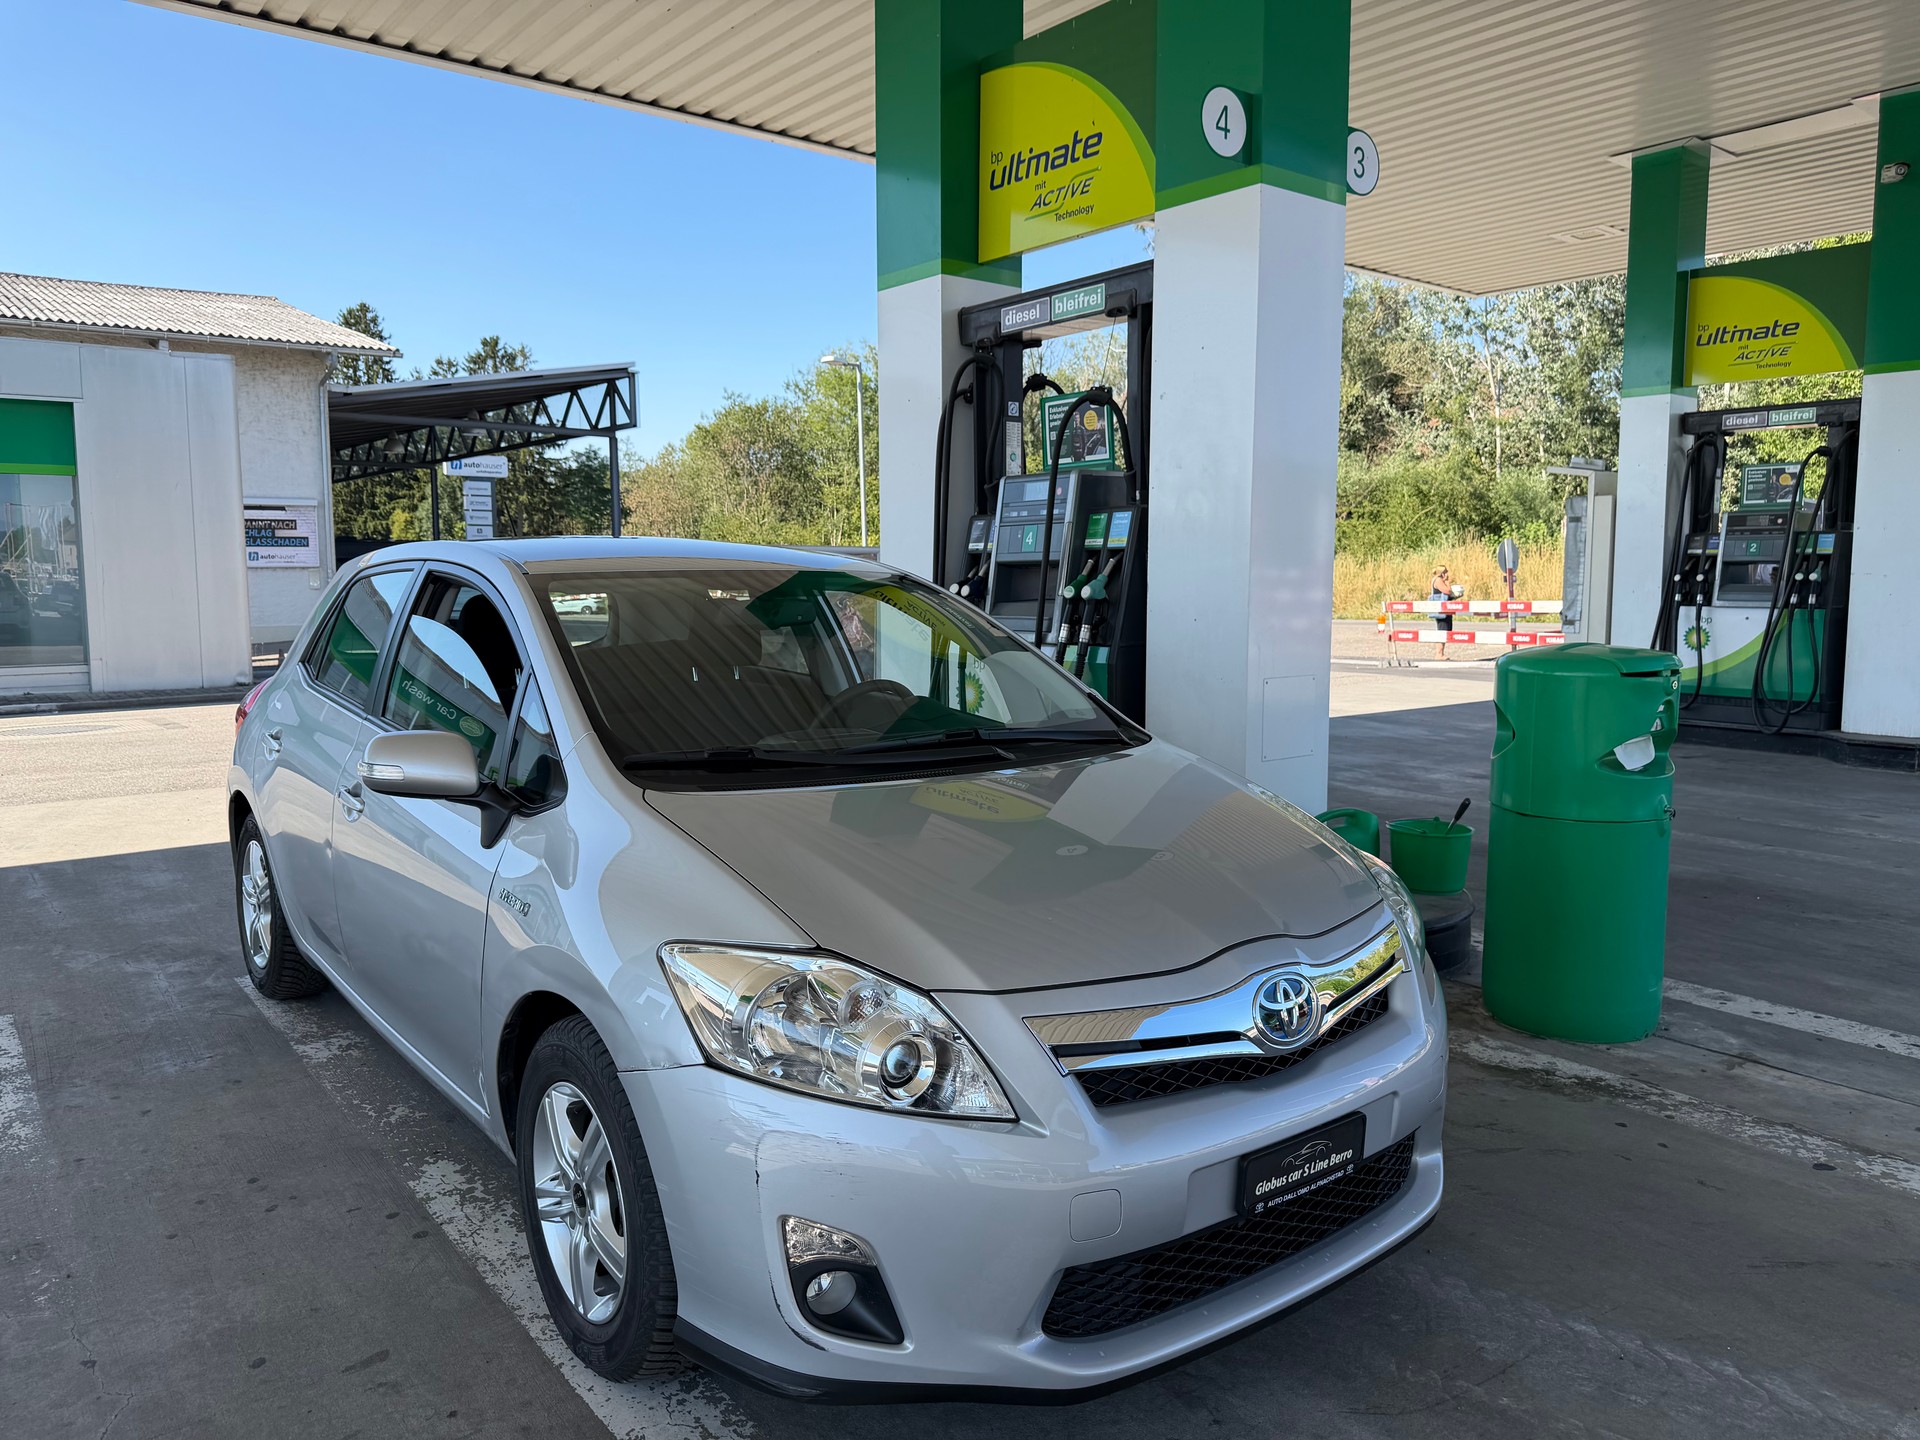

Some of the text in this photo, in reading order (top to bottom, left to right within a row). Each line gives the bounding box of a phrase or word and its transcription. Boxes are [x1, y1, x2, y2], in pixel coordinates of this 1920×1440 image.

[1215, 105, 1231, 140] 4
[989, 129, 1103, 191] ultimate
[990, 151, 1003, 166] bp
[1353, 146, 1365, 179] 3
[1034, 180, 1047, 192] mit
[1030, 176, 1094, 212] ACTIVE
[1054, 204, 1095, 222] Technology
[1005, 288, 1101, 326] diesel bleifrei
[1696, 319, 1800, 347] ultimate
[1697, 324, 1710, 333] bp
[1733, 346, 1792, 362] ACTIVE
[1756, 361, 1792, 370] Technology
[1726, 409, 1813, 426] diesel bleifrei
[463, 461, 503, 469] autohauser
[245, 520, 296, 529] ANNT NACH
[245, 538, 308, 546] GLASSCHADEN
[1025, 531, 1033, 545] 4
[1749, 543, 1757, 552] 2
[1255, 1149, 1353, 1196] Globus car S Line Berro
[1267, 1197, 1283, 1208] AUTO
